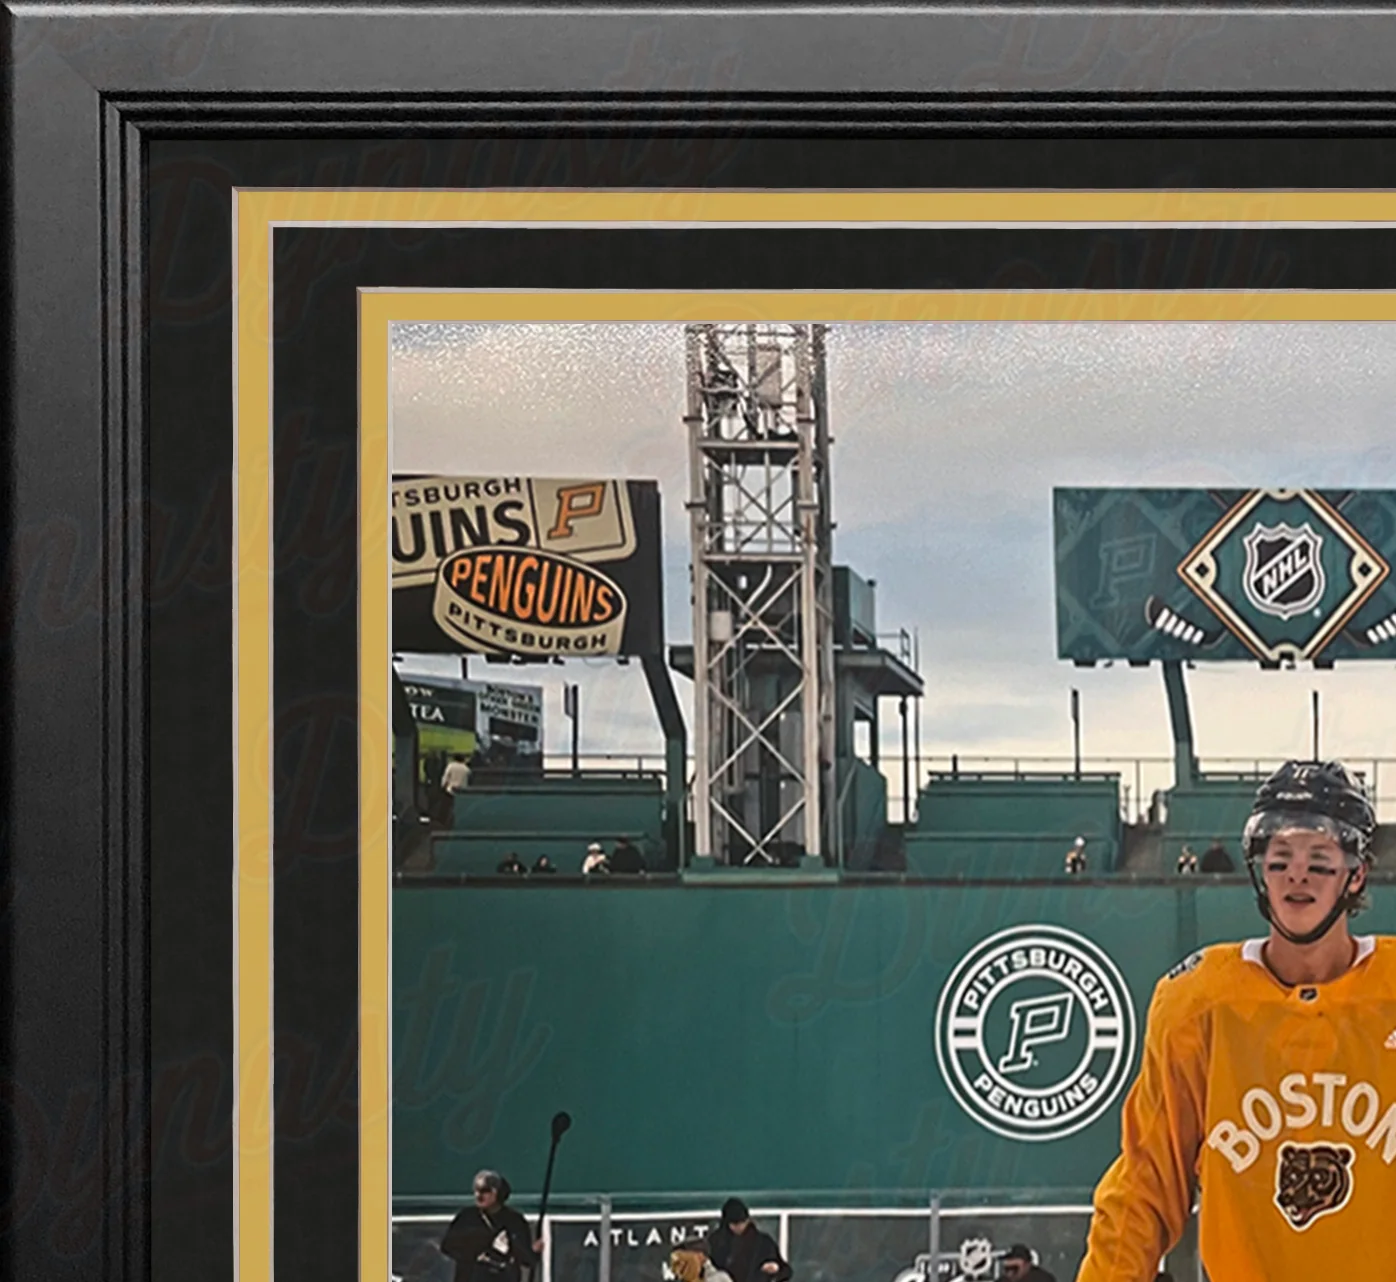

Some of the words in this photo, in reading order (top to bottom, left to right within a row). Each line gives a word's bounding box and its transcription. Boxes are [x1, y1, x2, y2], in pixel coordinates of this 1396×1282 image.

[451, 554, 614, 624] PENGUINS
[1262, 541, 1310, 599] NHL
[448, 602, 607, 651] PITTSBURGH
[962, 947, 1110, 1011] PITTSBURGH
[972, 1071, 1100, 1119] PENGUINS
